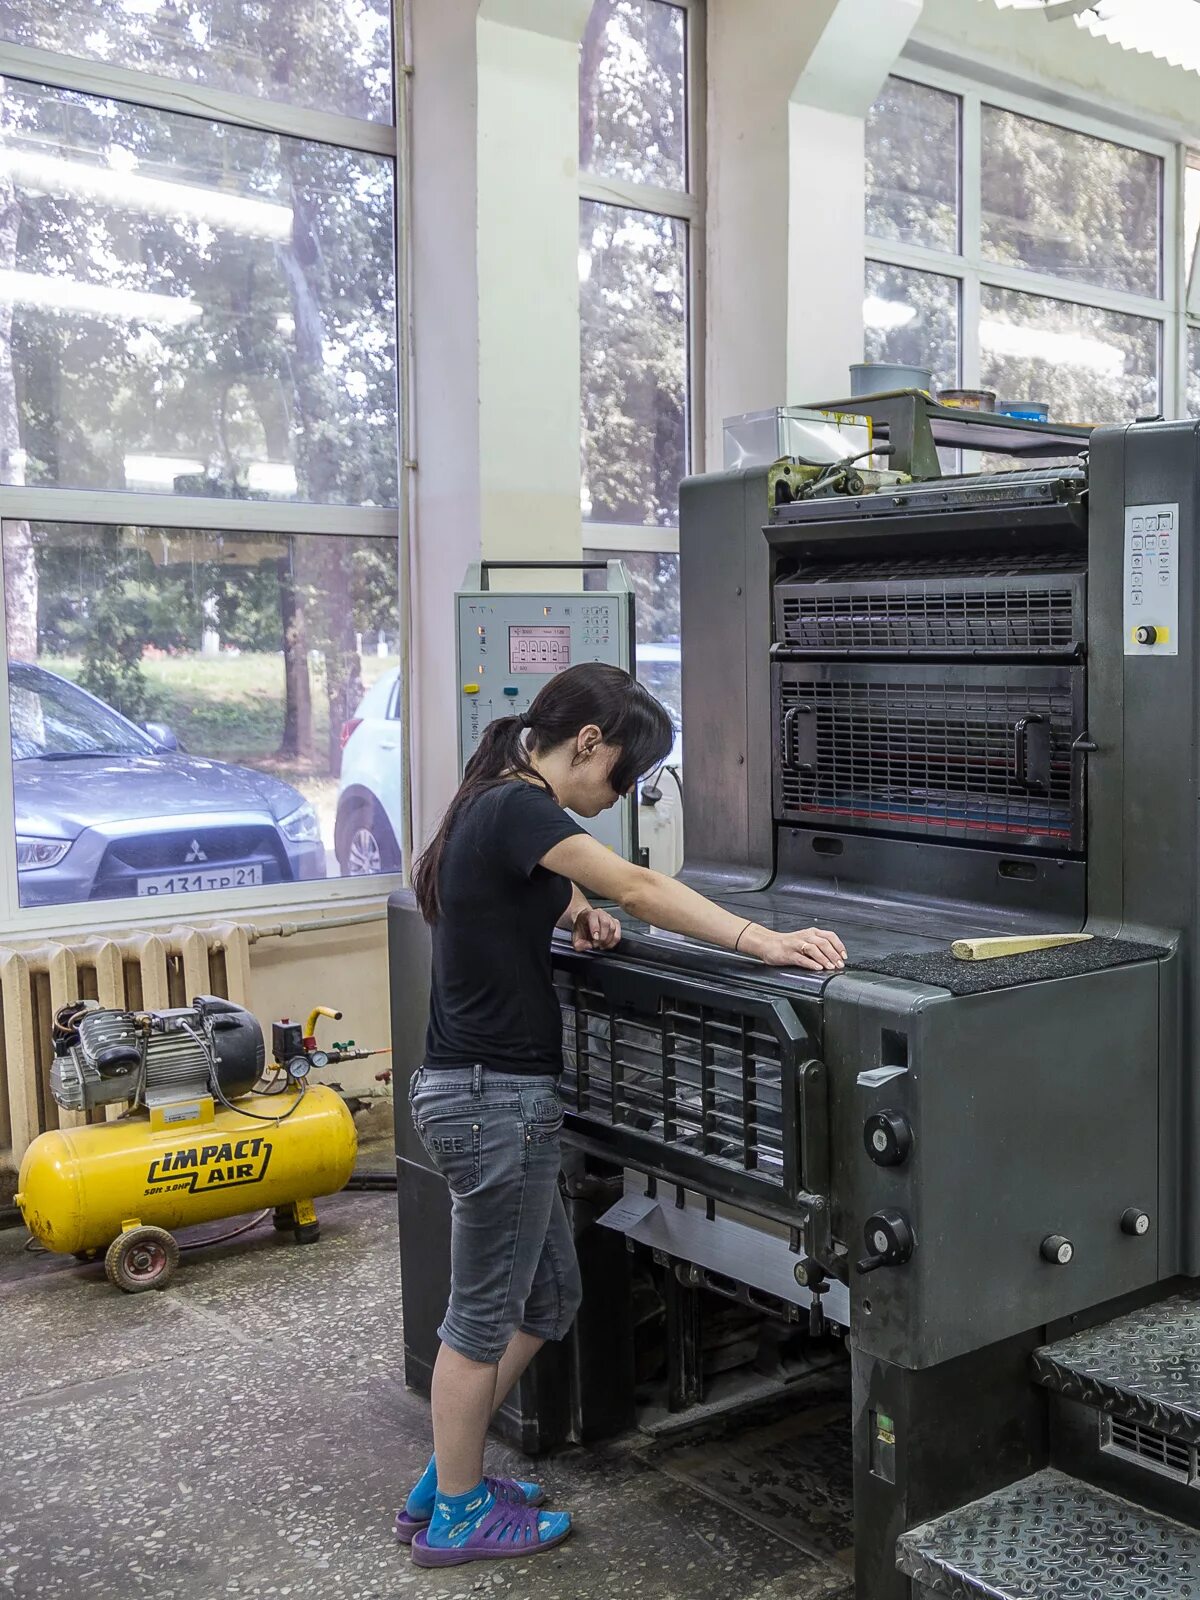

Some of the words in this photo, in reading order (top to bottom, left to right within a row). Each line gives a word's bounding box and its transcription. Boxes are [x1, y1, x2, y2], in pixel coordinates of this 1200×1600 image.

[236, 868, 256, 885] 21
[161, 1137, 264, 1172] IMPACT
[207, 1163, 254, 1184] AIR
